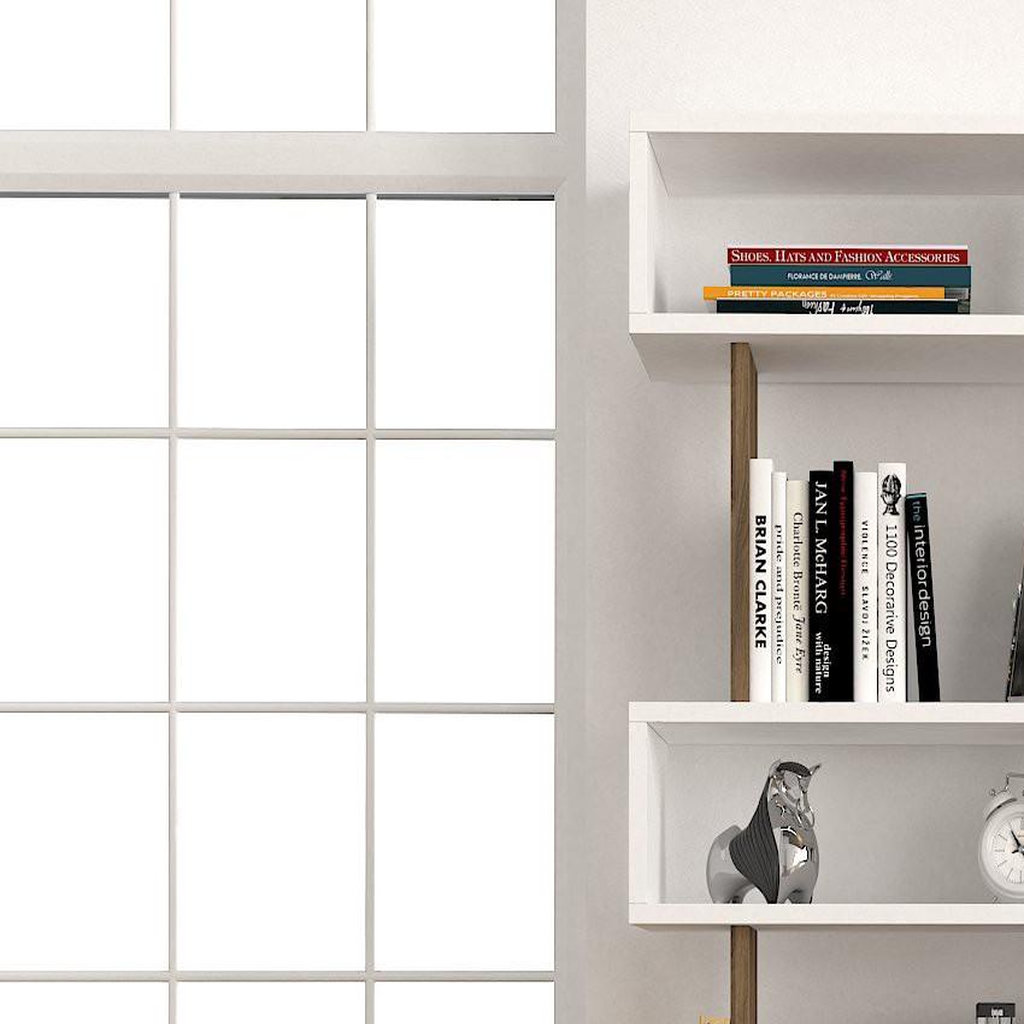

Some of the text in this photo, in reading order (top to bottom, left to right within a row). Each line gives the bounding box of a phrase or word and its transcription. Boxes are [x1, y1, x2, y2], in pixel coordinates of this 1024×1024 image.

[775, 250, 806, 262] HATS
[809, 252, 832, 262] AND
[834, 250, 882, 262] FASHION
[885, 250, 960, 262] ACCESSORIES
[819, 272, 829, 280] DE
[727, 290, 768, 298] PRETTY
[770, 290, 827, 298] PACKAGES
[814, 480, 828, 615] JAN L. McHARG
[886, 524, 898, 557] 1100
[754, 515, 767, 649] BRIAN CLARKE
[774, 524, 784, 665] pride and prejudice
[792, 512, 806, 674] Charlotte Brontë Jane Eyre
[912, 501, 932, 648] the interior design
[862, 586, 870, 624] SLAVOJ
[815, 632, 824, 694] with nature
[822, 644, 832, 678] design
[882, 640, 899, 693] Designs
